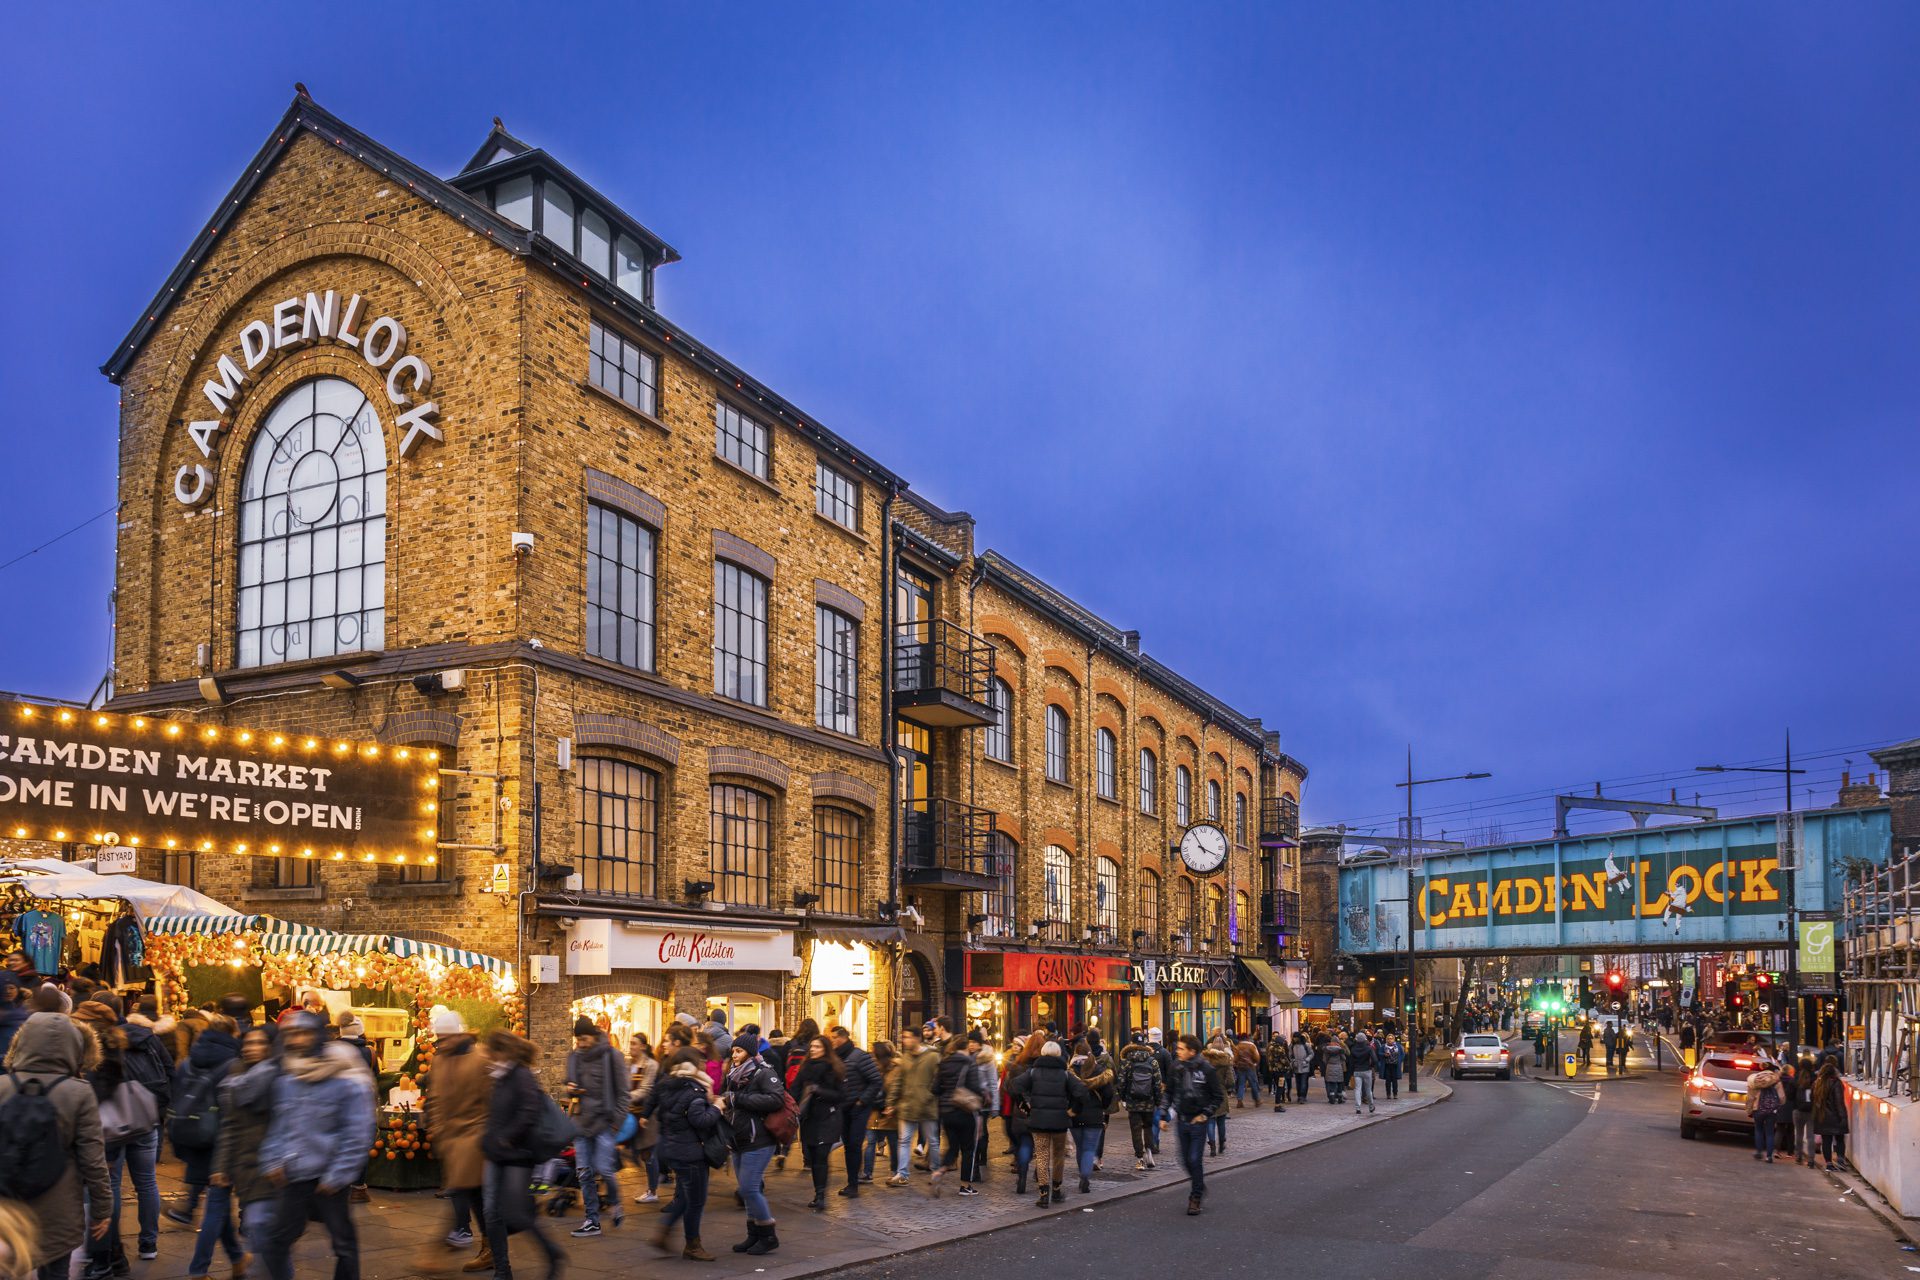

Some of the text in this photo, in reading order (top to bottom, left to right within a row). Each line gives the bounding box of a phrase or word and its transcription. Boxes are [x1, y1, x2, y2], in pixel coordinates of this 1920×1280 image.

[174, 289, 444, 505] CAMDEN LOCK
[176, 754, 332, 792] MARKET
[90, 784, 127, 812] IN
[143, 789, 251, 823] WE'RE
[263, 800, 353, 830] OPEN
[253, 803, 261, 820] VERY
[99, 851, 133, 862] EAST YARD
[1418, 858, 1779, 927] CAMDEN LOCK
[659, 932, 736, 963] Cath Kidston
